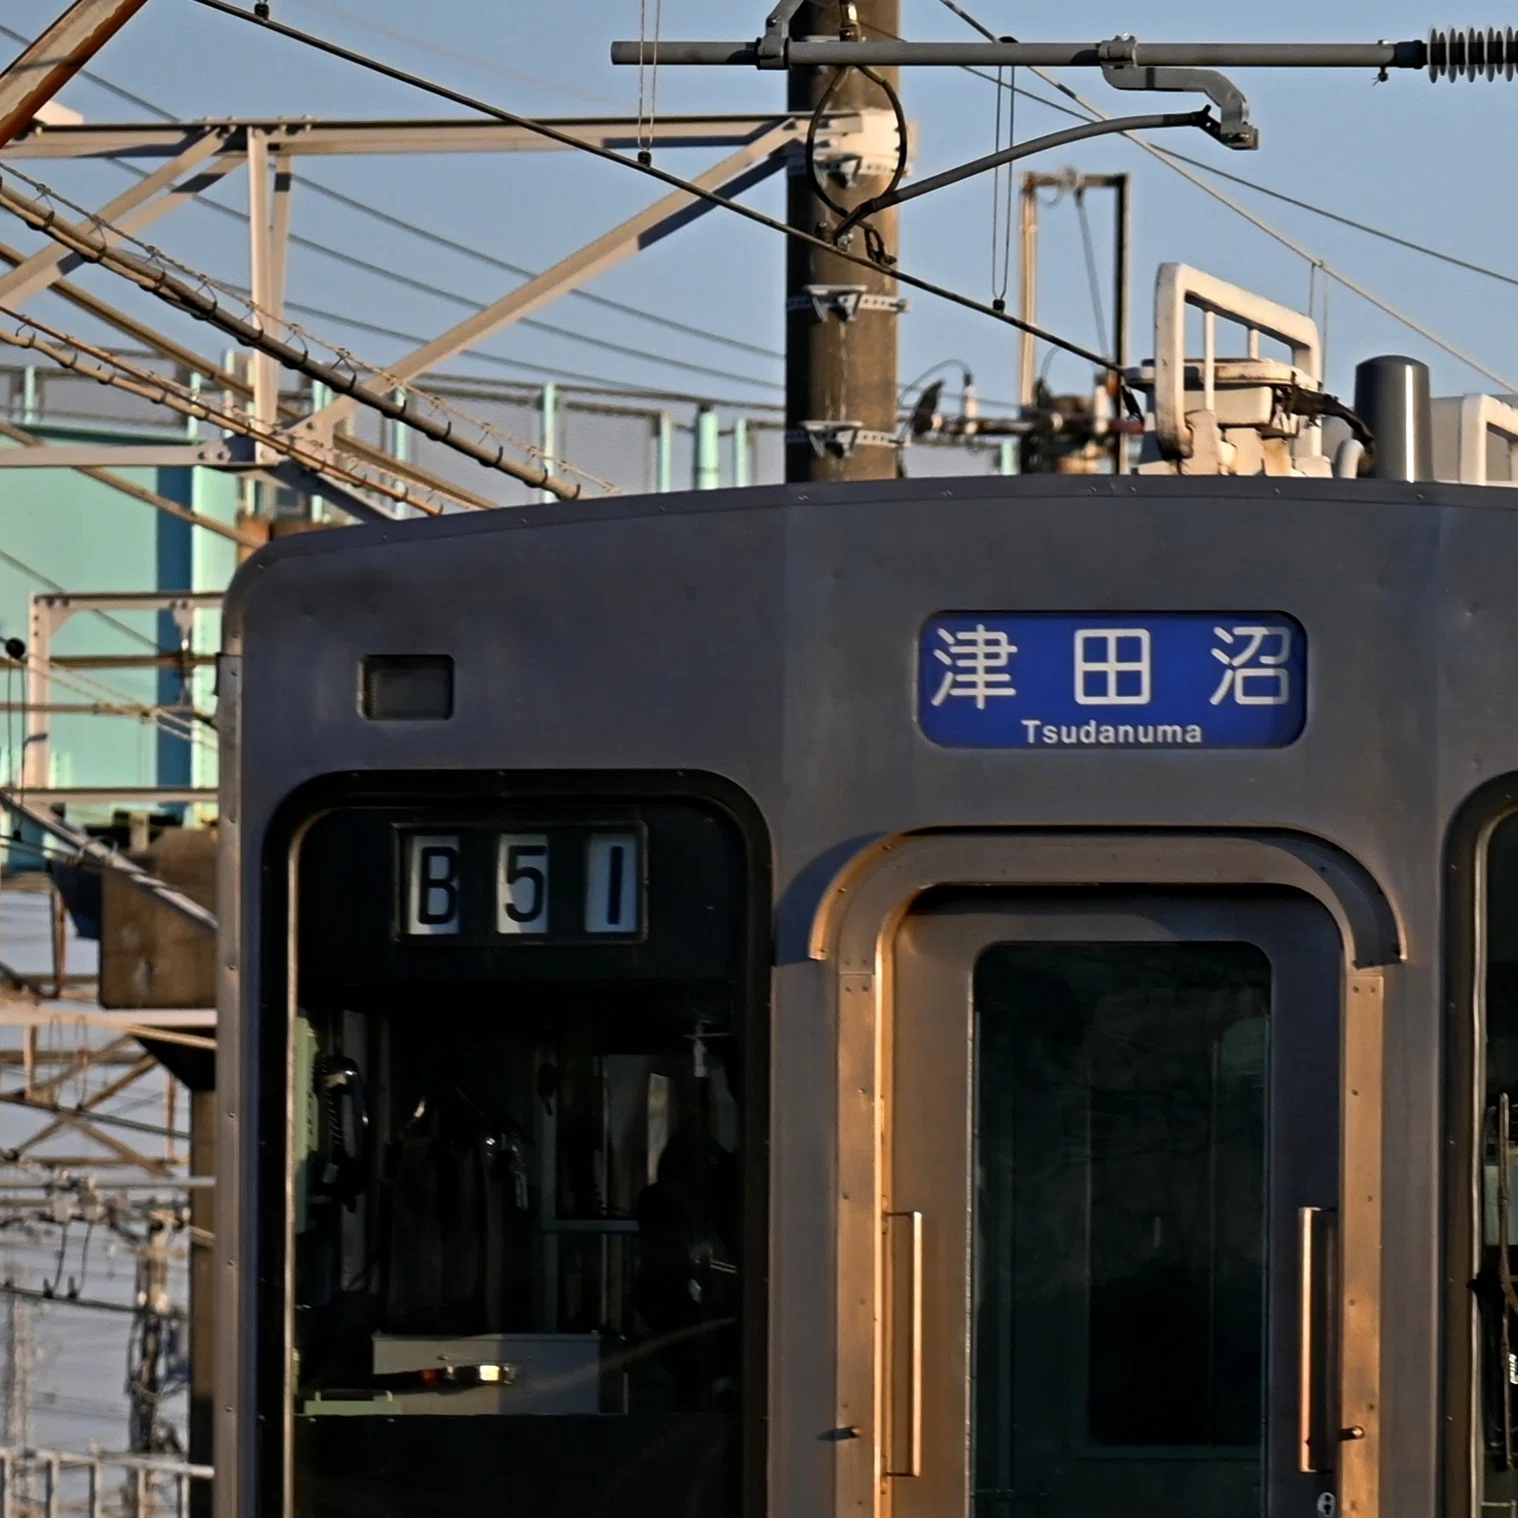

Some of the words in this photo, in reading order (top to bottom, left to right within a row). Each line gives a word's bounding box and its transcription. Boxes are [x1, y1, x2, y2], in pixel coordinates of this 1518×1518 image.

[931, 624, 1291, 711] 津田沼
[1022, 718, 1202, 745] Tsudanuma
[418, 846, 624, 925] B51
